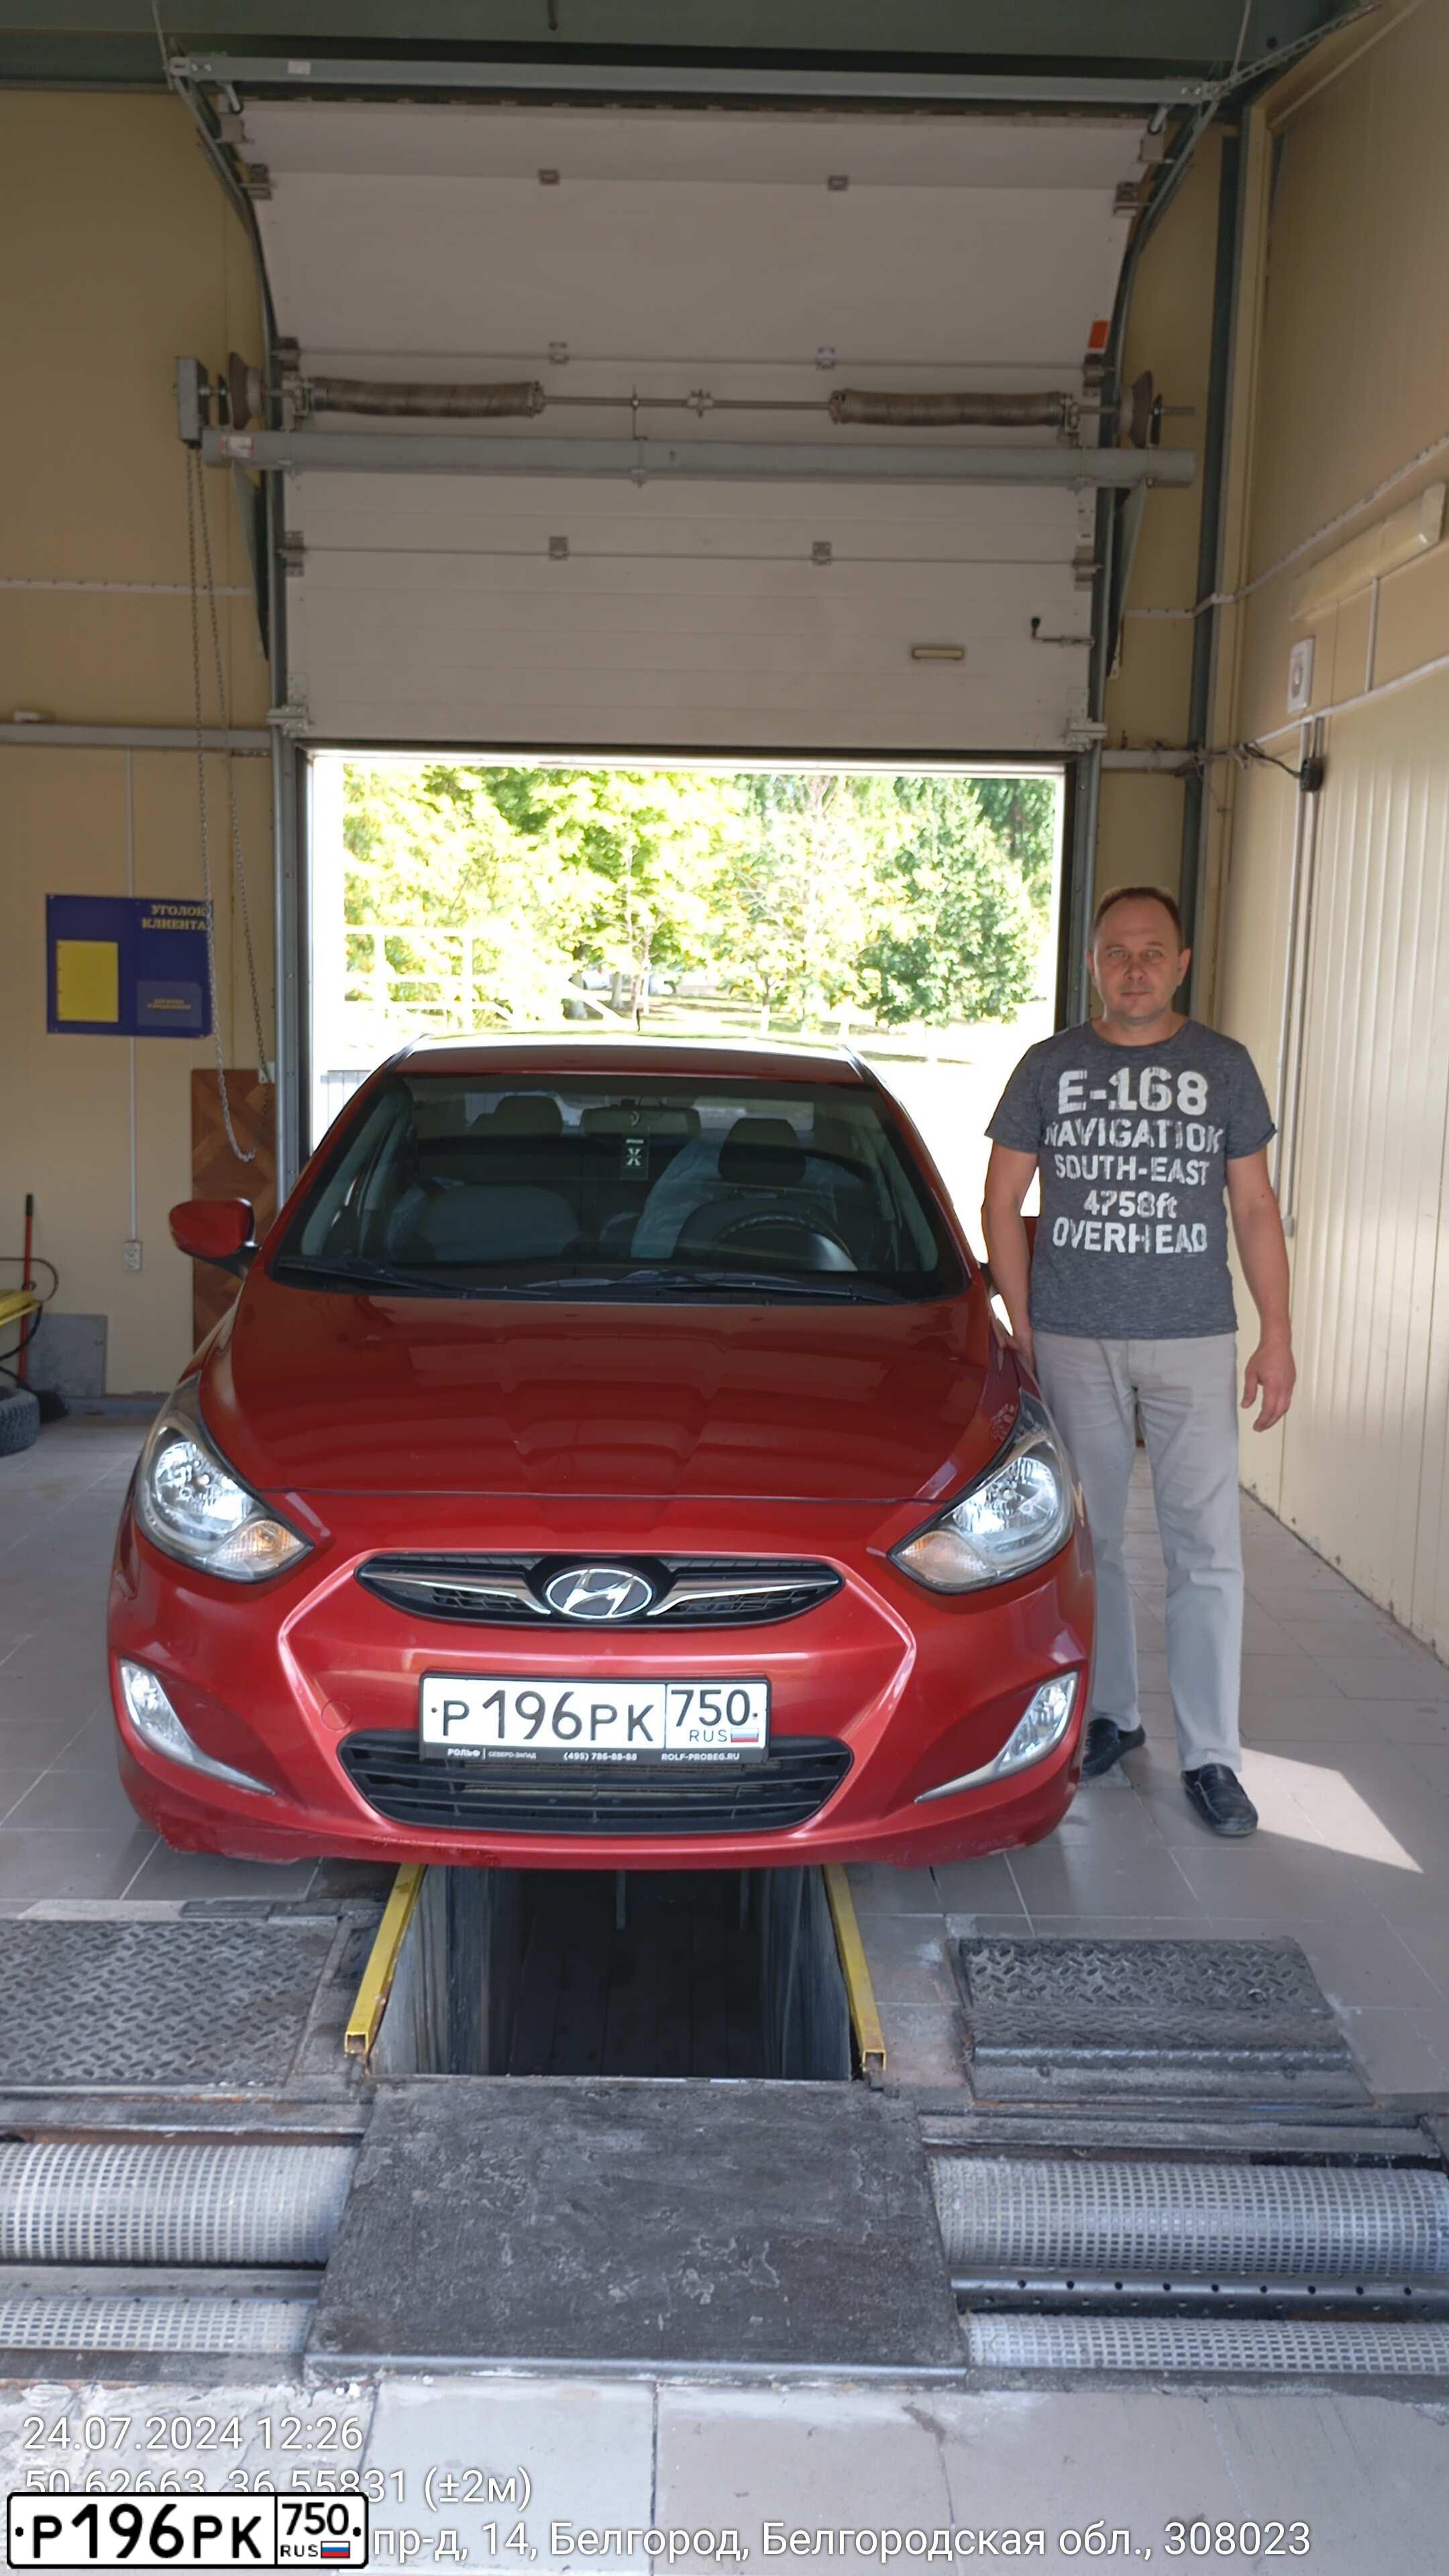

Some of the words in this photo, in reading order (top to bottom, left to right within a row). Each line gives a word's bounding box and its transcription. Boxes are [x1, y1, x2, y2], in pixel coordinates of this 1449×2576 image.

[142, 918, 206, 930] КЛИЕНТА
[1057, 1067, 1208, 1116] E-168
[1055, 1154, 1210, 1185] SOUTH-EAST
[1083, 1189, 1177, 1219] 4758ft
[1052, 1216, 1208, 1254] OVERHEAD
[670, 1688, 751, 1727] 750
[689, 1729, 727, 1743] RUS
[447, 1748, 480, 1757] РОЛЬФ
[661, 1753, 740, 1761] ROLF-PROBEG.RU
